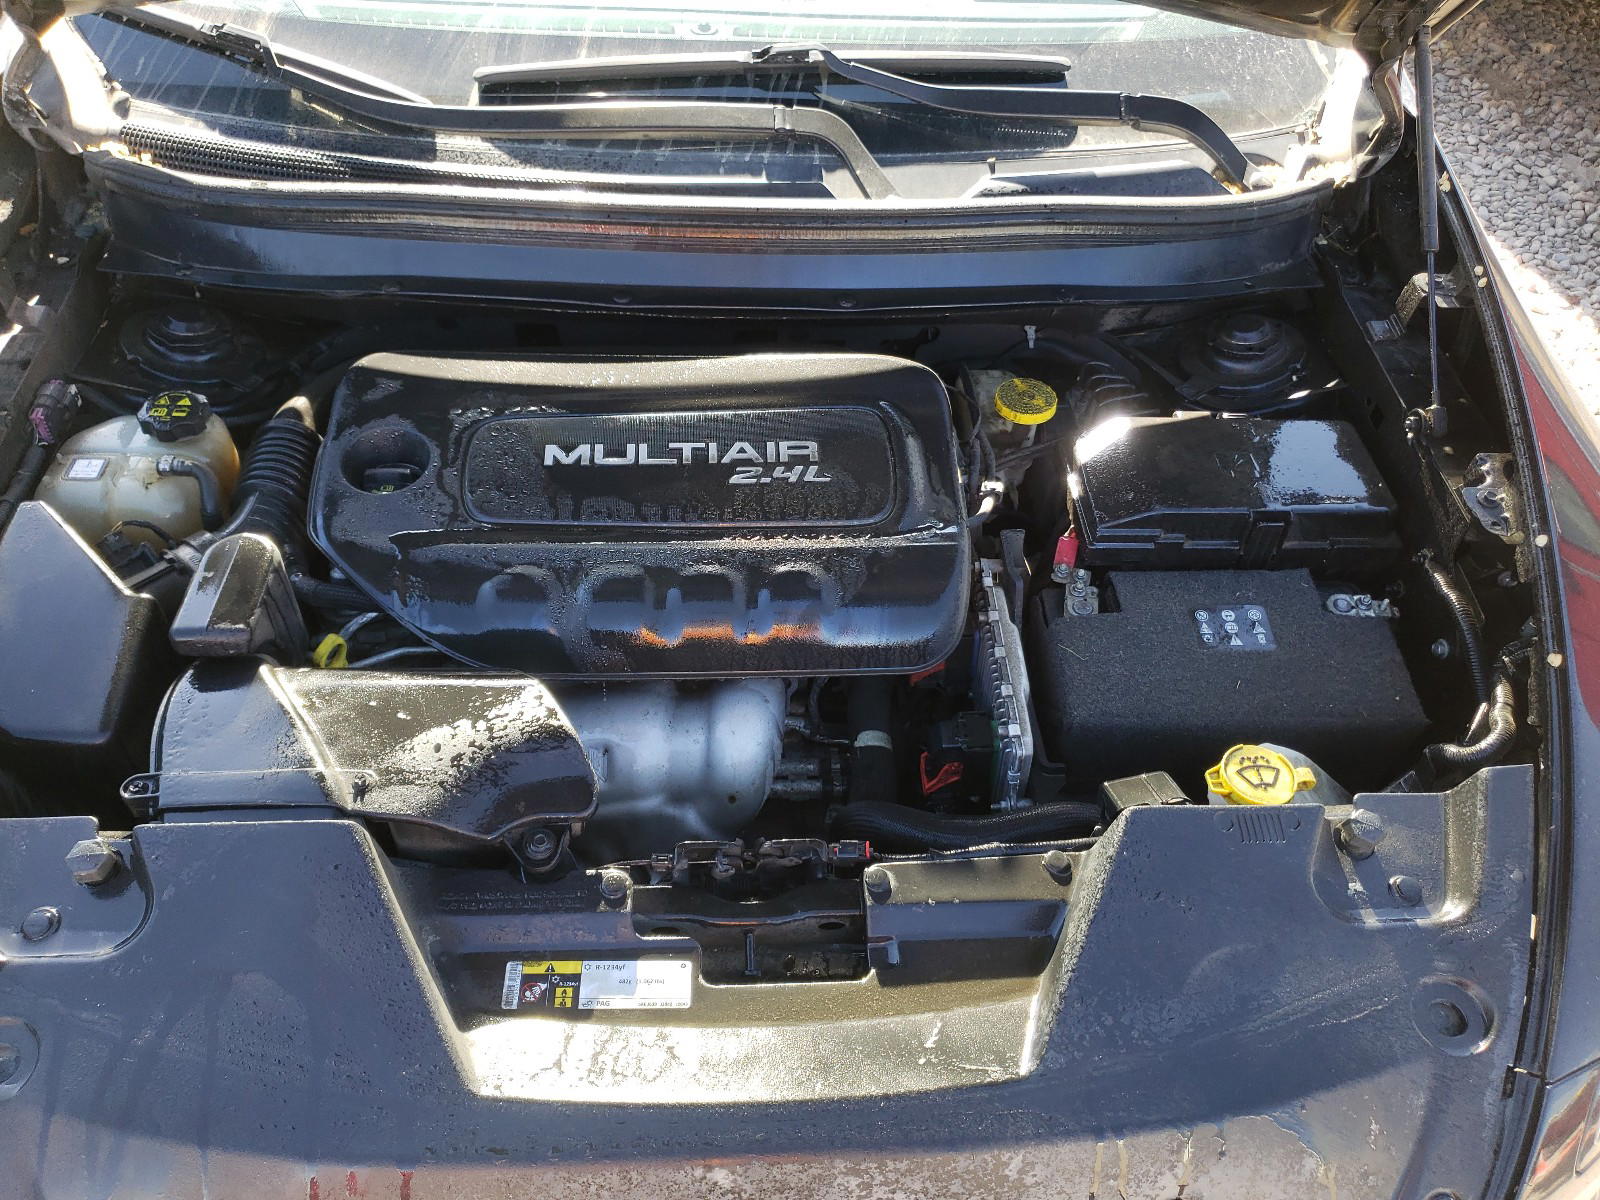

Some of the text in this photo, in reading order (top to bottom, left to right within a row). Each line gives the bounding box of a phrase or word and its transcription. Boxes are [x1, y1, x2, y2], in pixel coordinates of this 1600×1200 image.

[543, 440, 819, 466] MULTIAIR
[728, 465, 832, 484] 2.4L
[595, 963, 626, 972] R-1234yf
